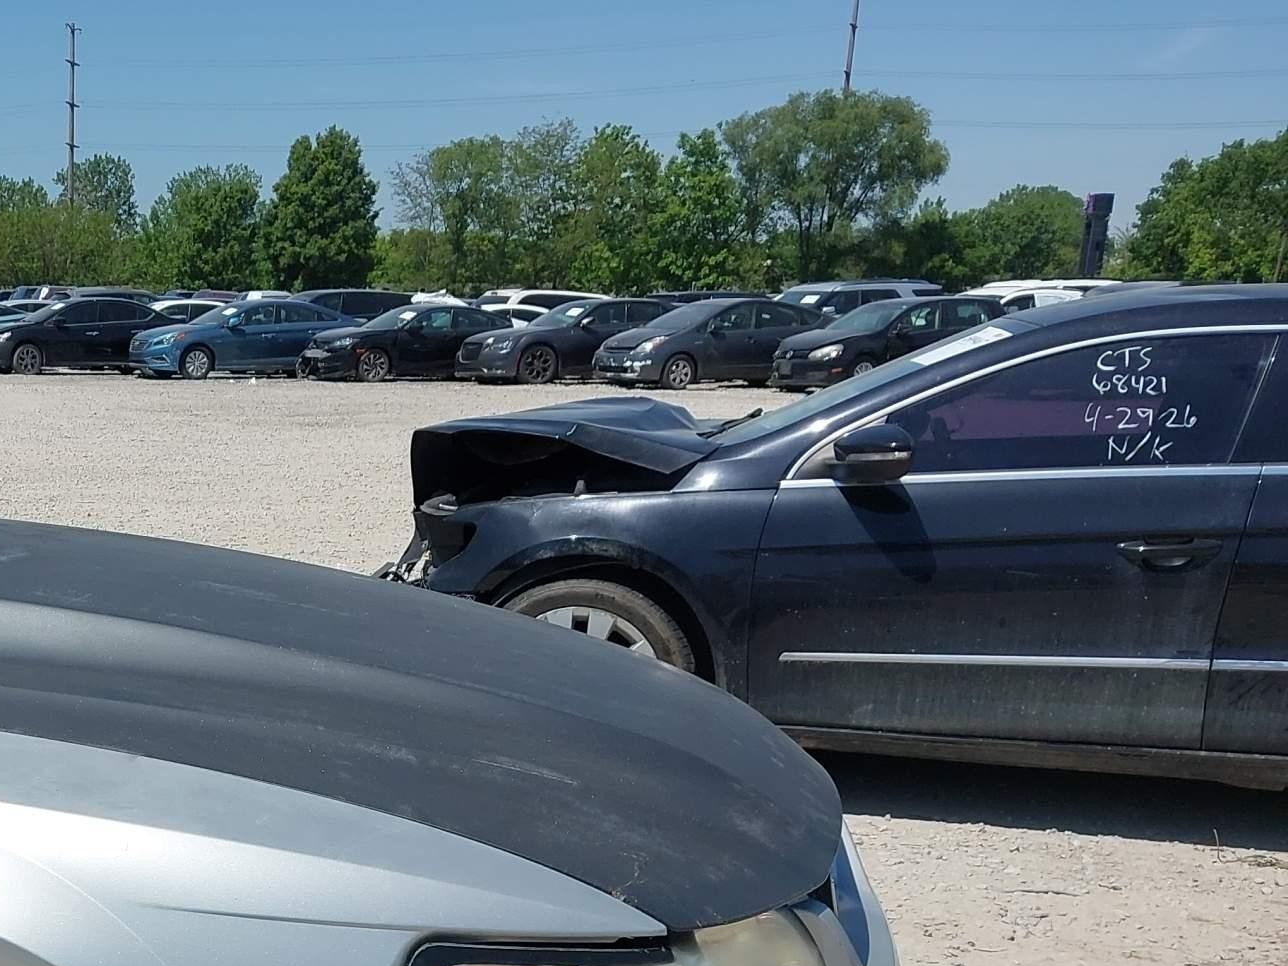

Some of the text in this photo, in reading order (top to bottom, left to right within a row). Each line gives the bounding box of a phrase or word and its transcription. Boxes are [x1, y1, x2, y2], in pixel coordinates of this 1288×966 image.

[1096, 346, 1153, 371] CTS
[1092, 373, 1168, 396] 68421
[1107, 431, 1174, 461] N/K
